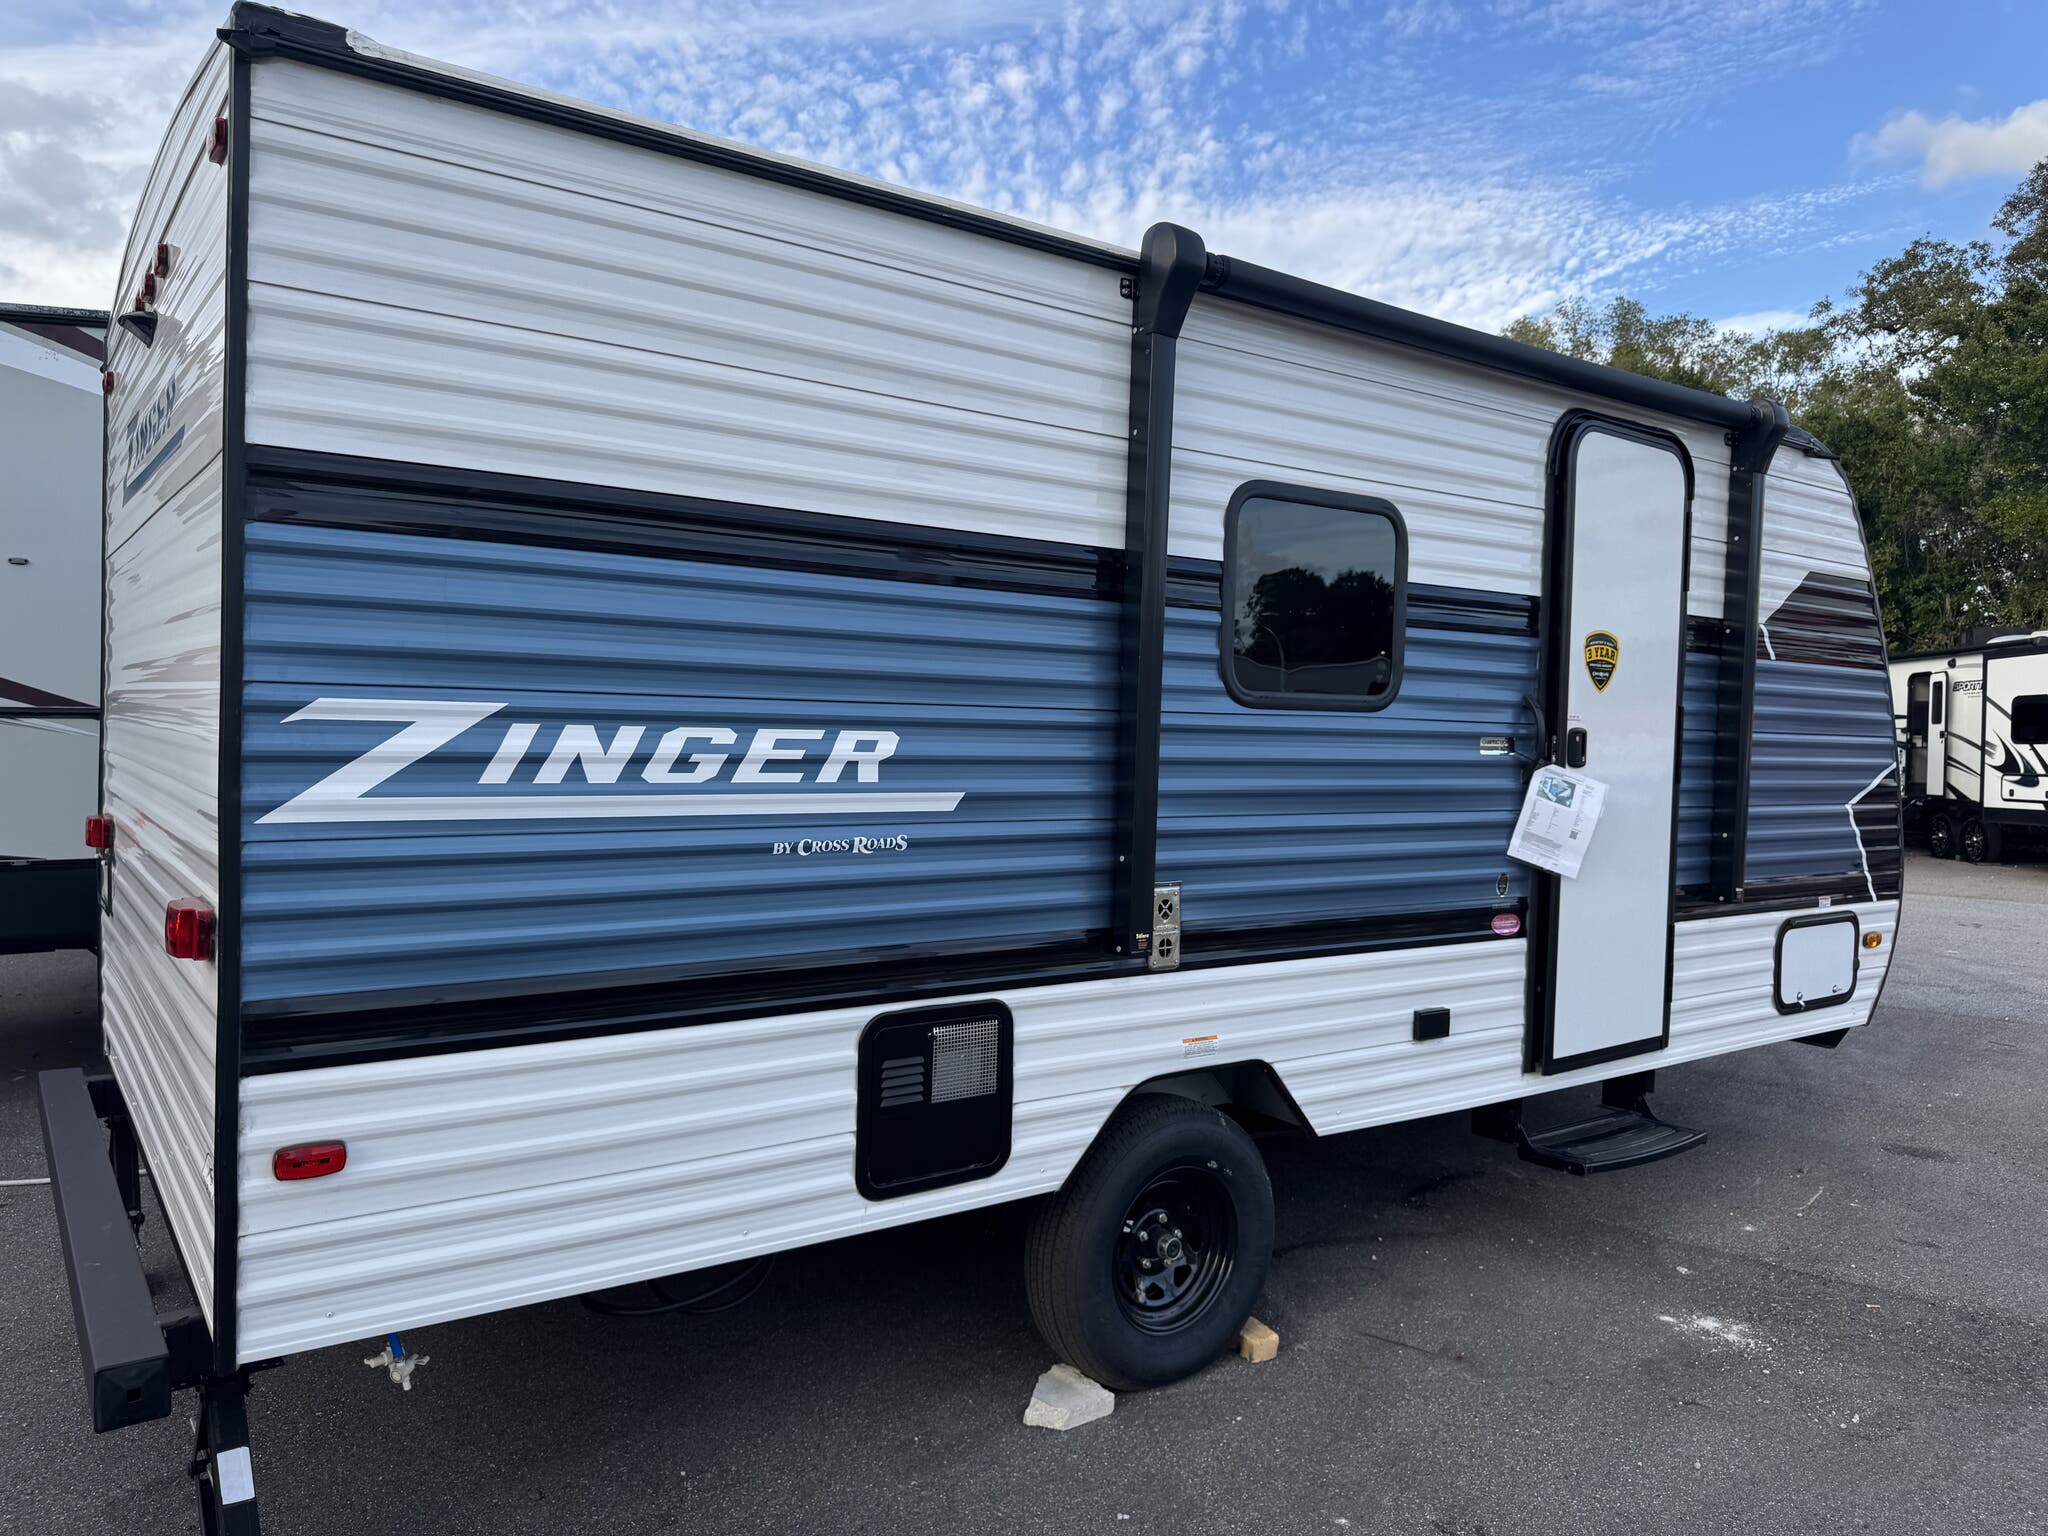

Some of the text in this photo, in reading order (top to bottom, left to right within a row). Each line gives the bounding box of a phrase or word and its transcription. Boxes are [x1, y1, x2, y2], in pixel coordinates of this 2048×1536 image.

[1587, 646, 1616, 662] 3 YEAR
[255, 697, 966, 824] ZINGER
[773, 841, 794, 855] BY
